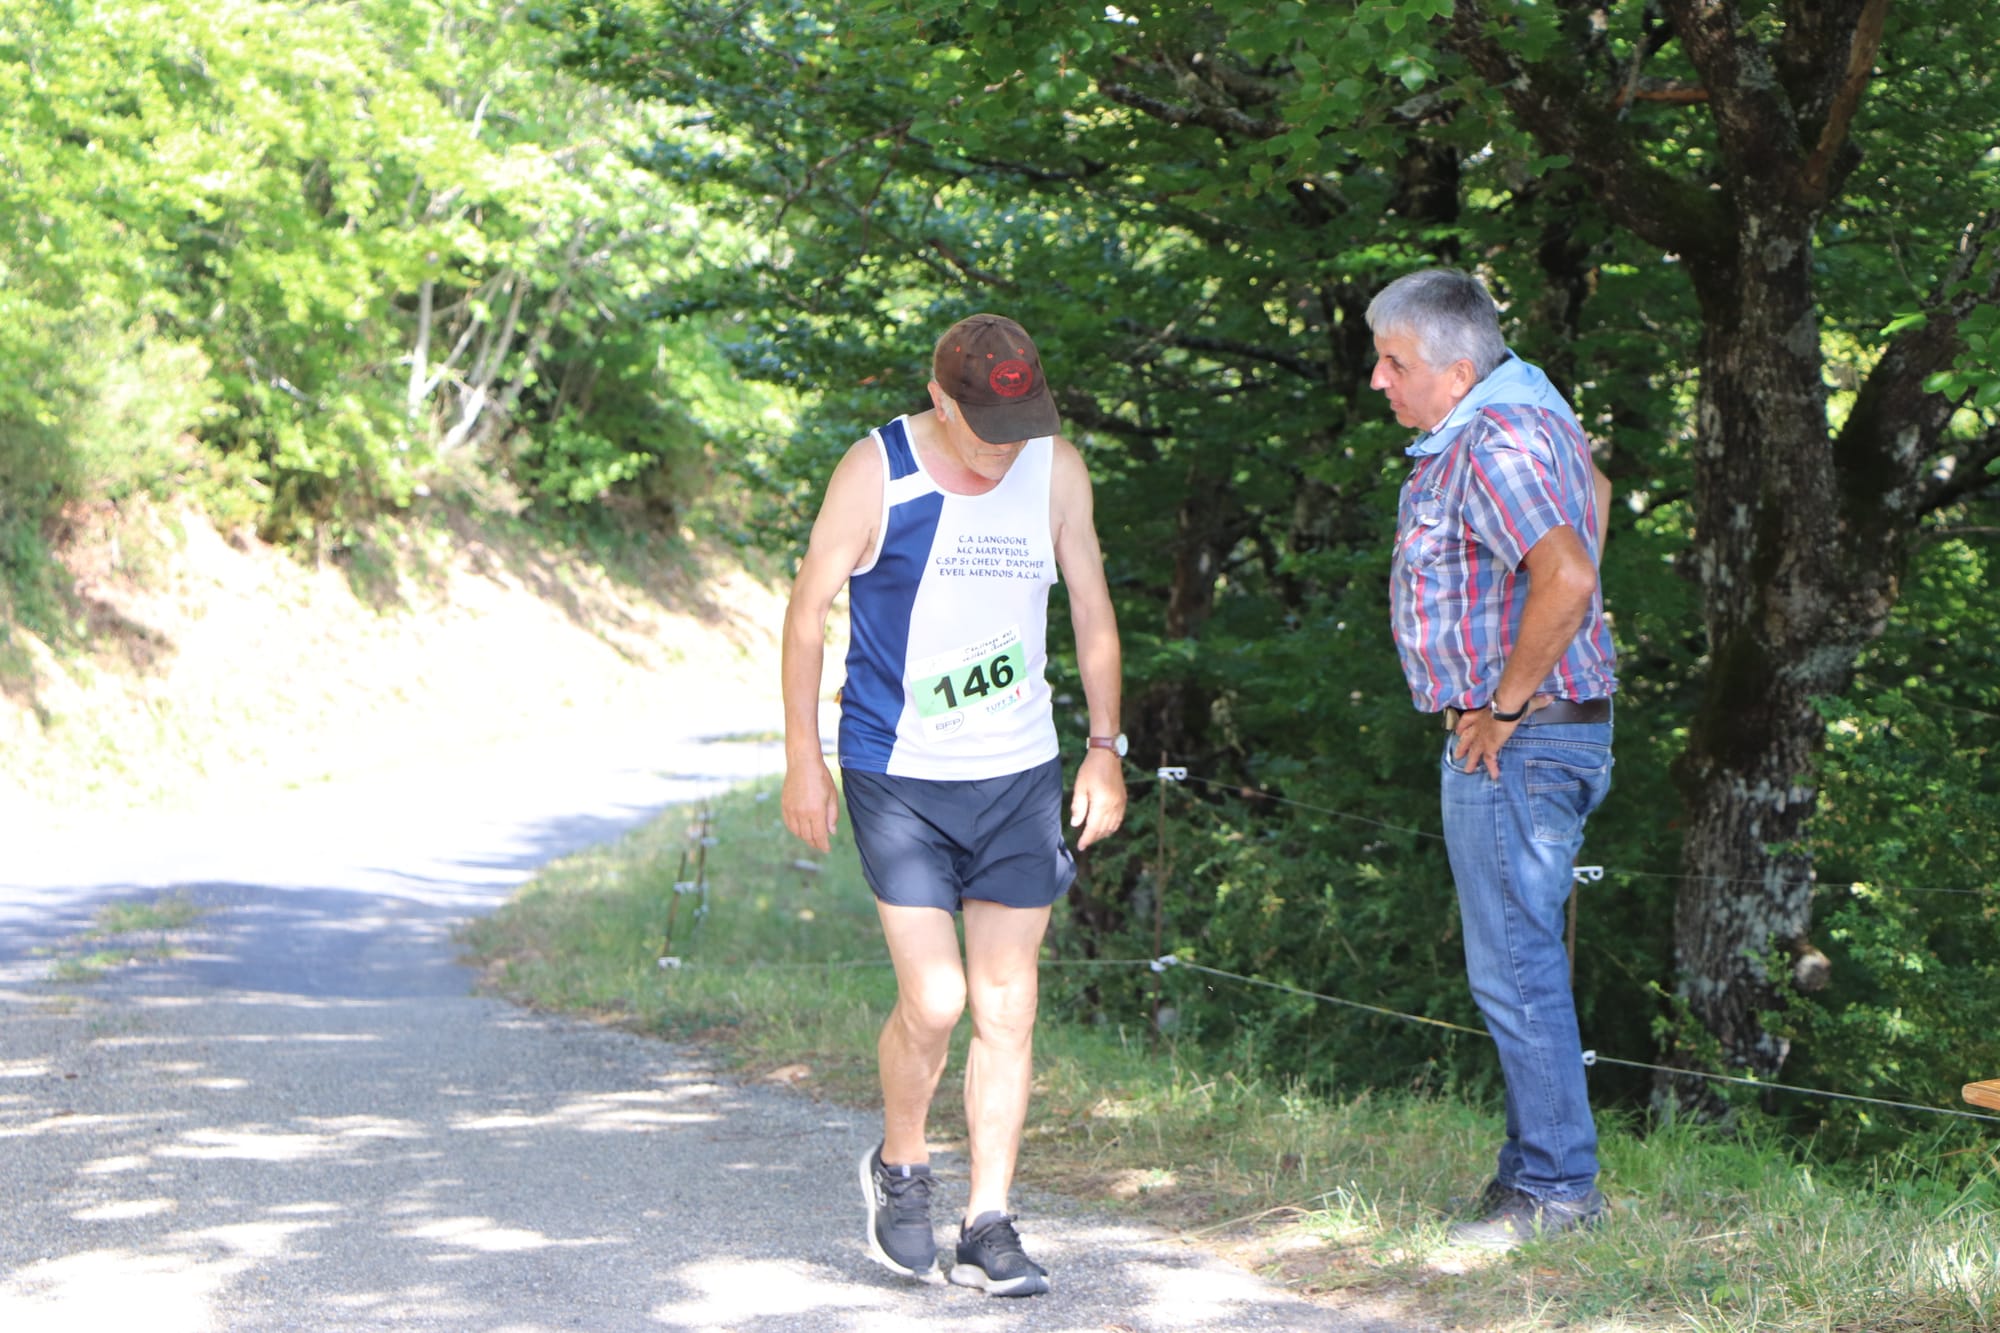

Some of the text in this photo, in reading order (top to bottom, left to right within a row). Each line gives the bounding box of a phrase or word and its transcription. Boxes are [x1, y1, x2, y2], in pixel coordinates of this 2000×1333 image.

[978, 536, 1028, 546] LANGOGNE
[975, 547, 1030, 557] MARVEJOLS
[971, 557, 1001, 566] CHELY
[939, 568, 966, 577] EVEIL
[969, 568, 1014, 578] MENDOIS
[933, 654, 1014, 709] 146
